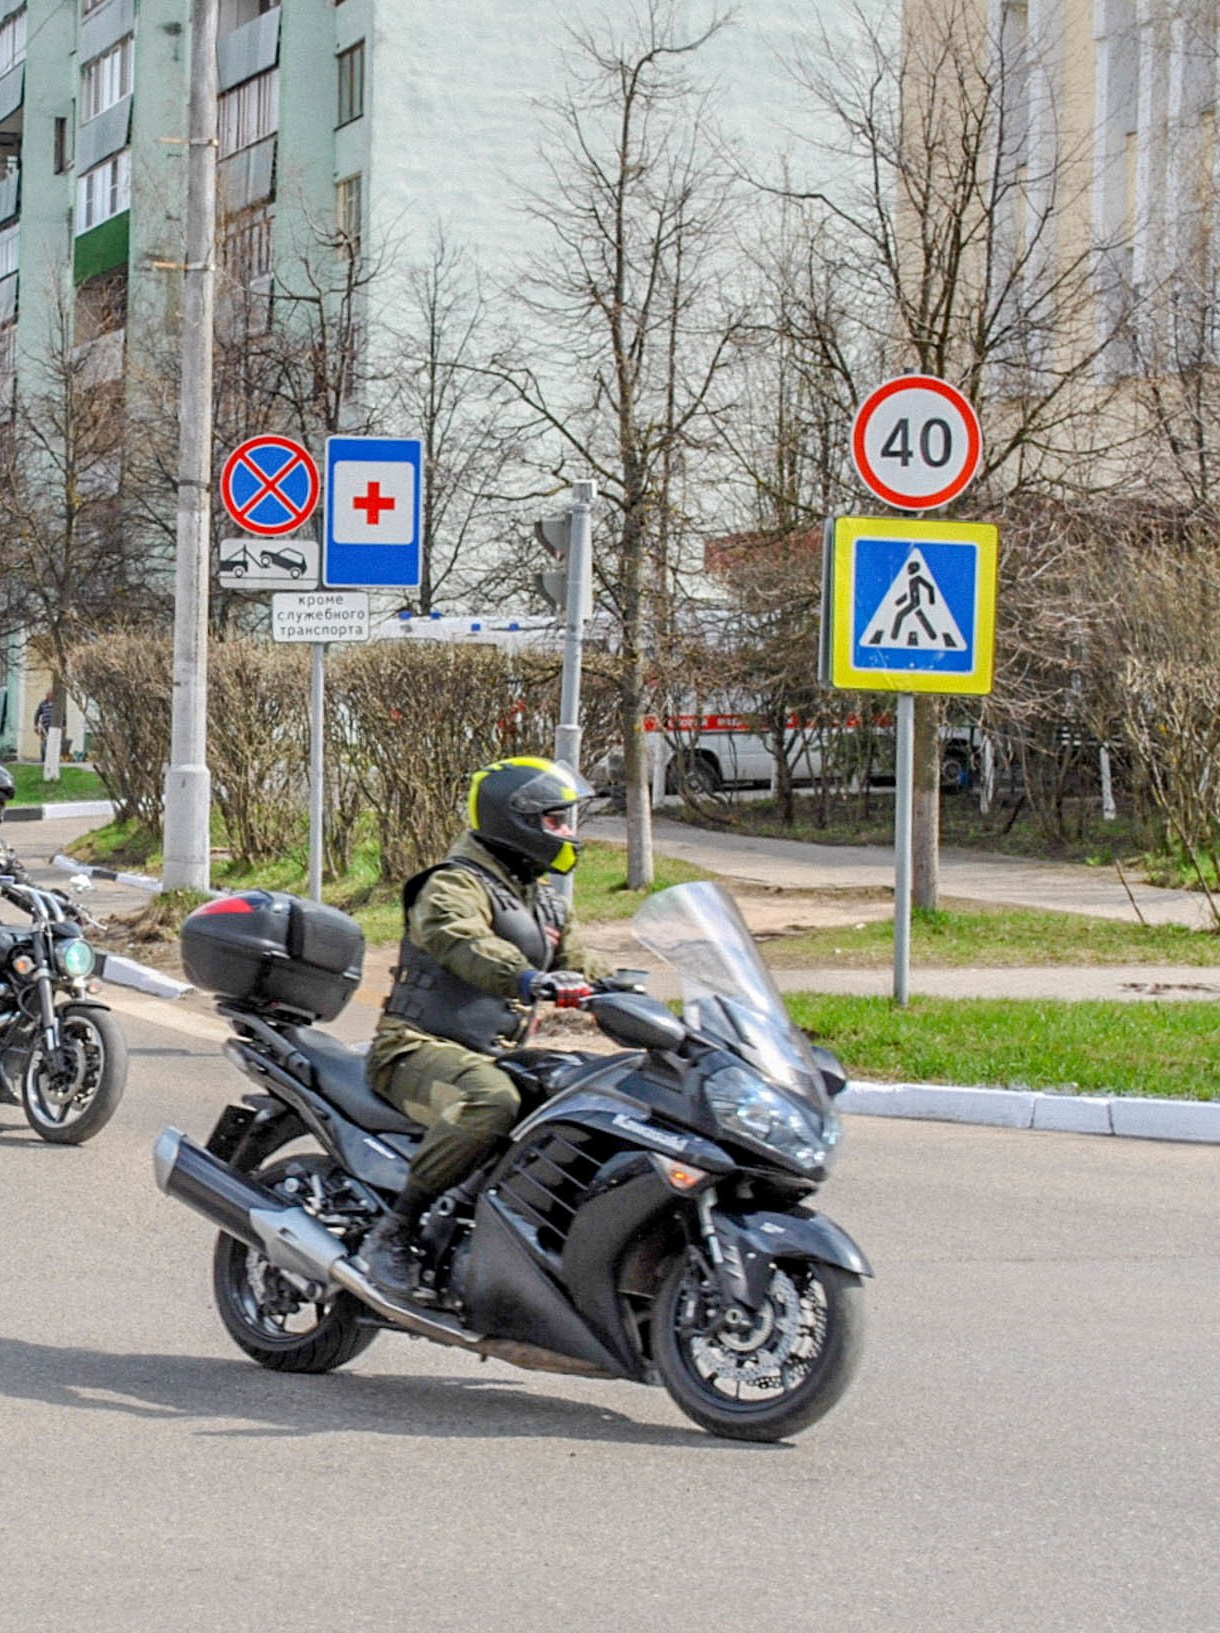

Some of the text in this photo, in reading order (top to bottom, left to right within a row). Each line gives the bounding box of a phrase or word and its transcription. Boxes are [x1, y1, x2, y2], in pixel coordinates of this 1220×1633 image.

[880, 418, 953, 467] 40
[298, 596, 344, 608] кроме
[277, 608, 365, 623] служебного
[281, 625, 364, 637] транспорта
